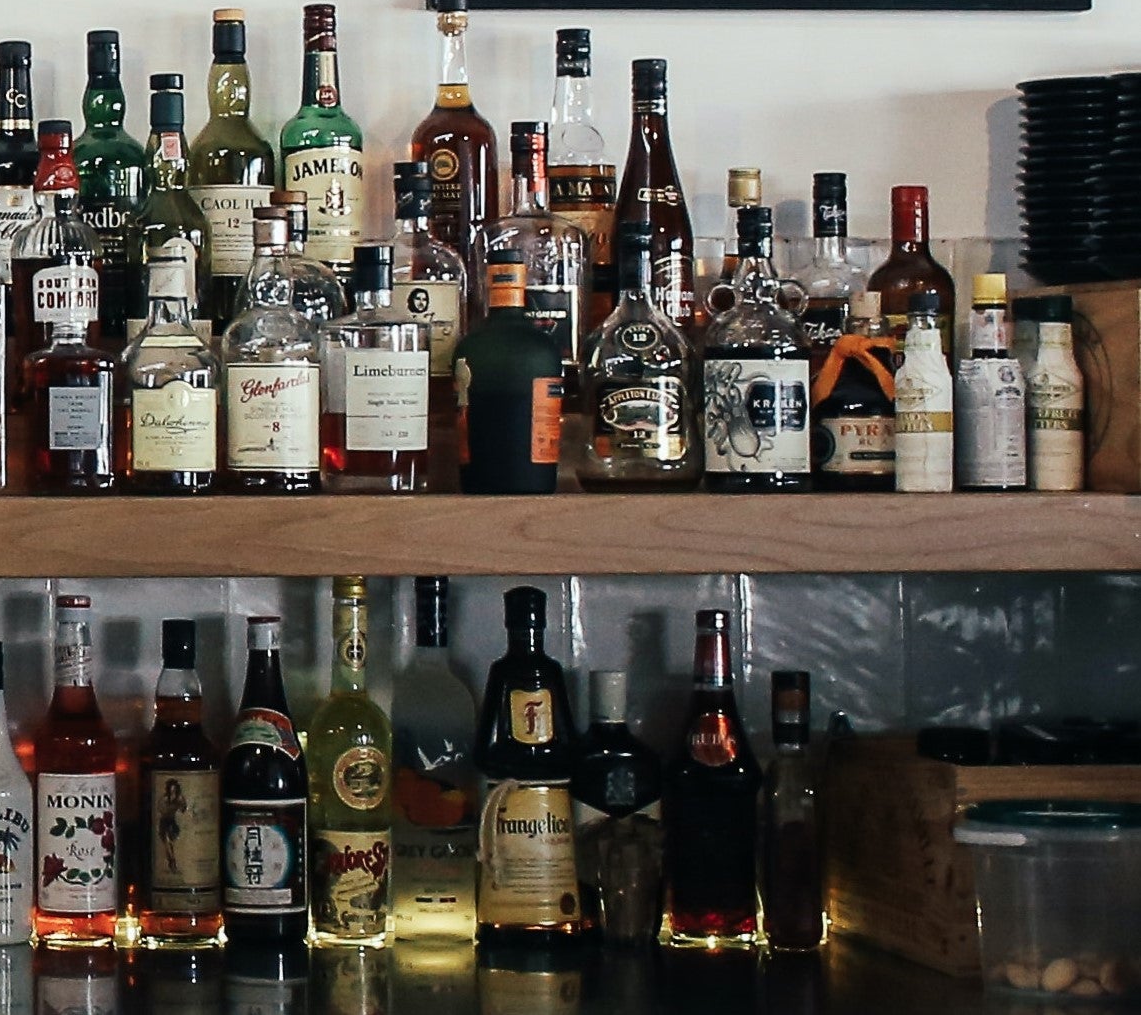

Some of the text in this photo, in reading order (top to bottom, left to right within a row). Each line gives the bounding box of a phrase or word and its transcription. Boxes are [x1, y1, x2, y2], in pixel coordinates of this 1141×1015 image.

[200, 197, 240, 210] CAOL
[226, 217, 241, 230] 12
[271, 421, 281, 433] 8
[46, 794, 114, 809] MONIN
